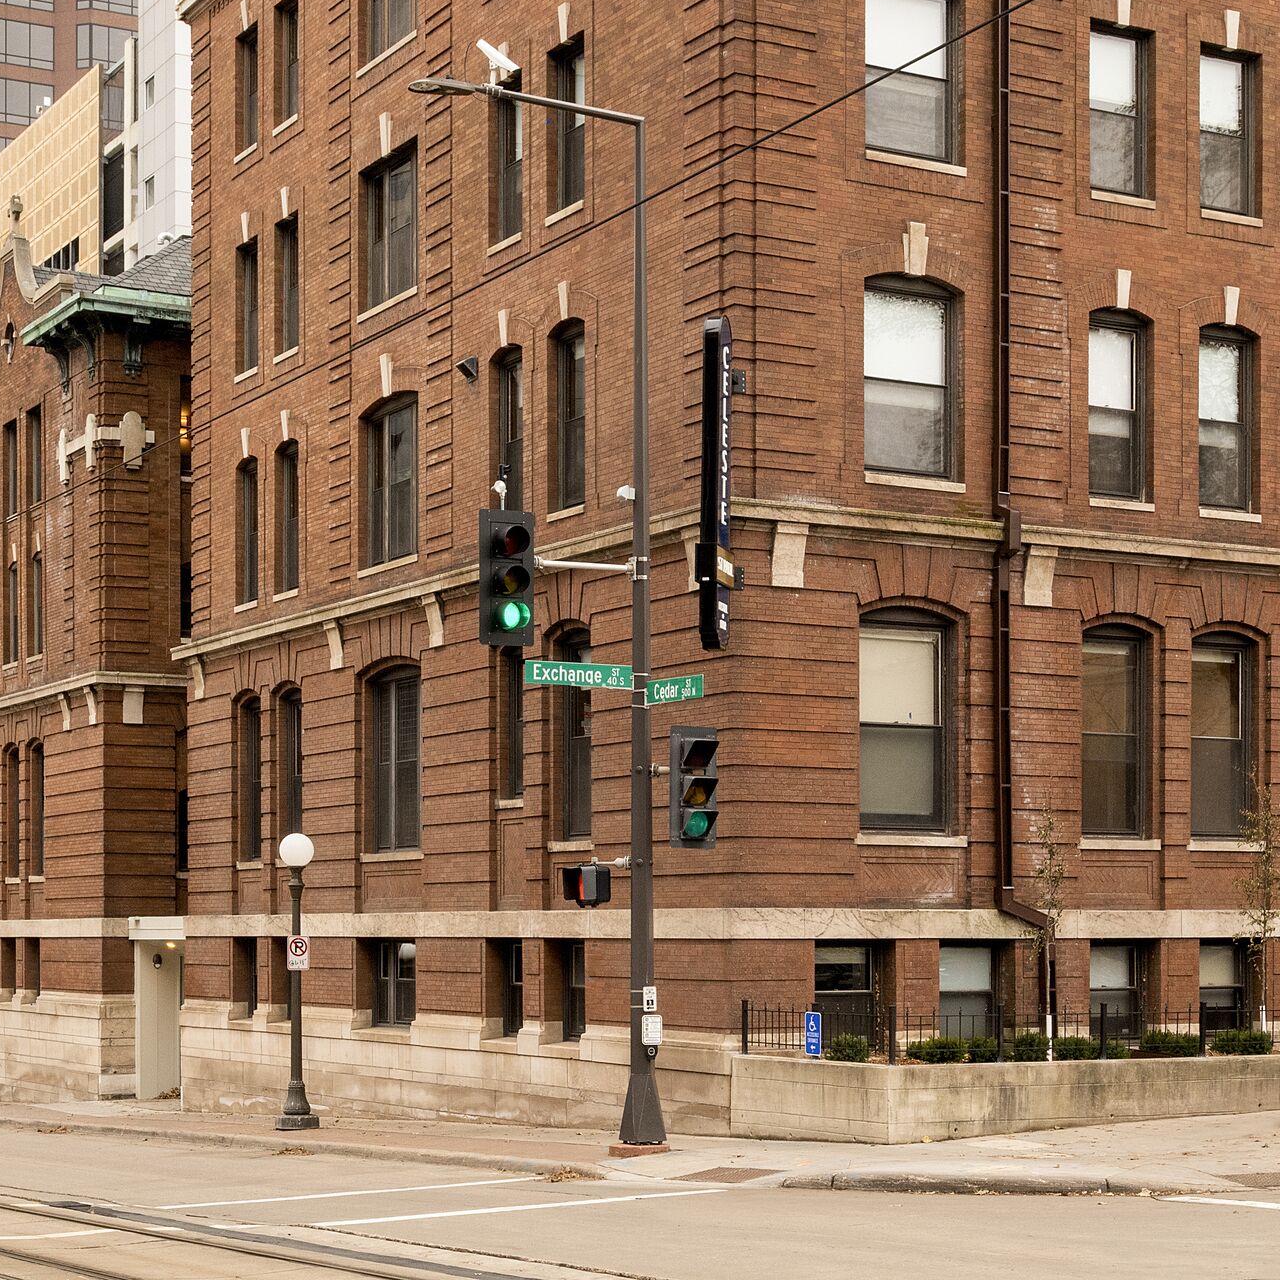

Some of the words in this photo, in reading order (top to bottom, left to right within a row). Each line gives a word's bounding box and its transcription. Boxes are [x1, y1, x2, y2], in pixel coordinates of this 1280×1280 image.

[721, 346, 730, 526] CELESTE
[533, 664, 602, 684] Exchange
[611, 668, 620, 676] ST
[607, 676, 617, 686] 40
[619, 677, 624, 686] S
[654, 682, 679, 700] Cedar
[685, 678, 691, 687] ST
[681, 687, 691, 697] 500
[692, 687, 696, 696] N
